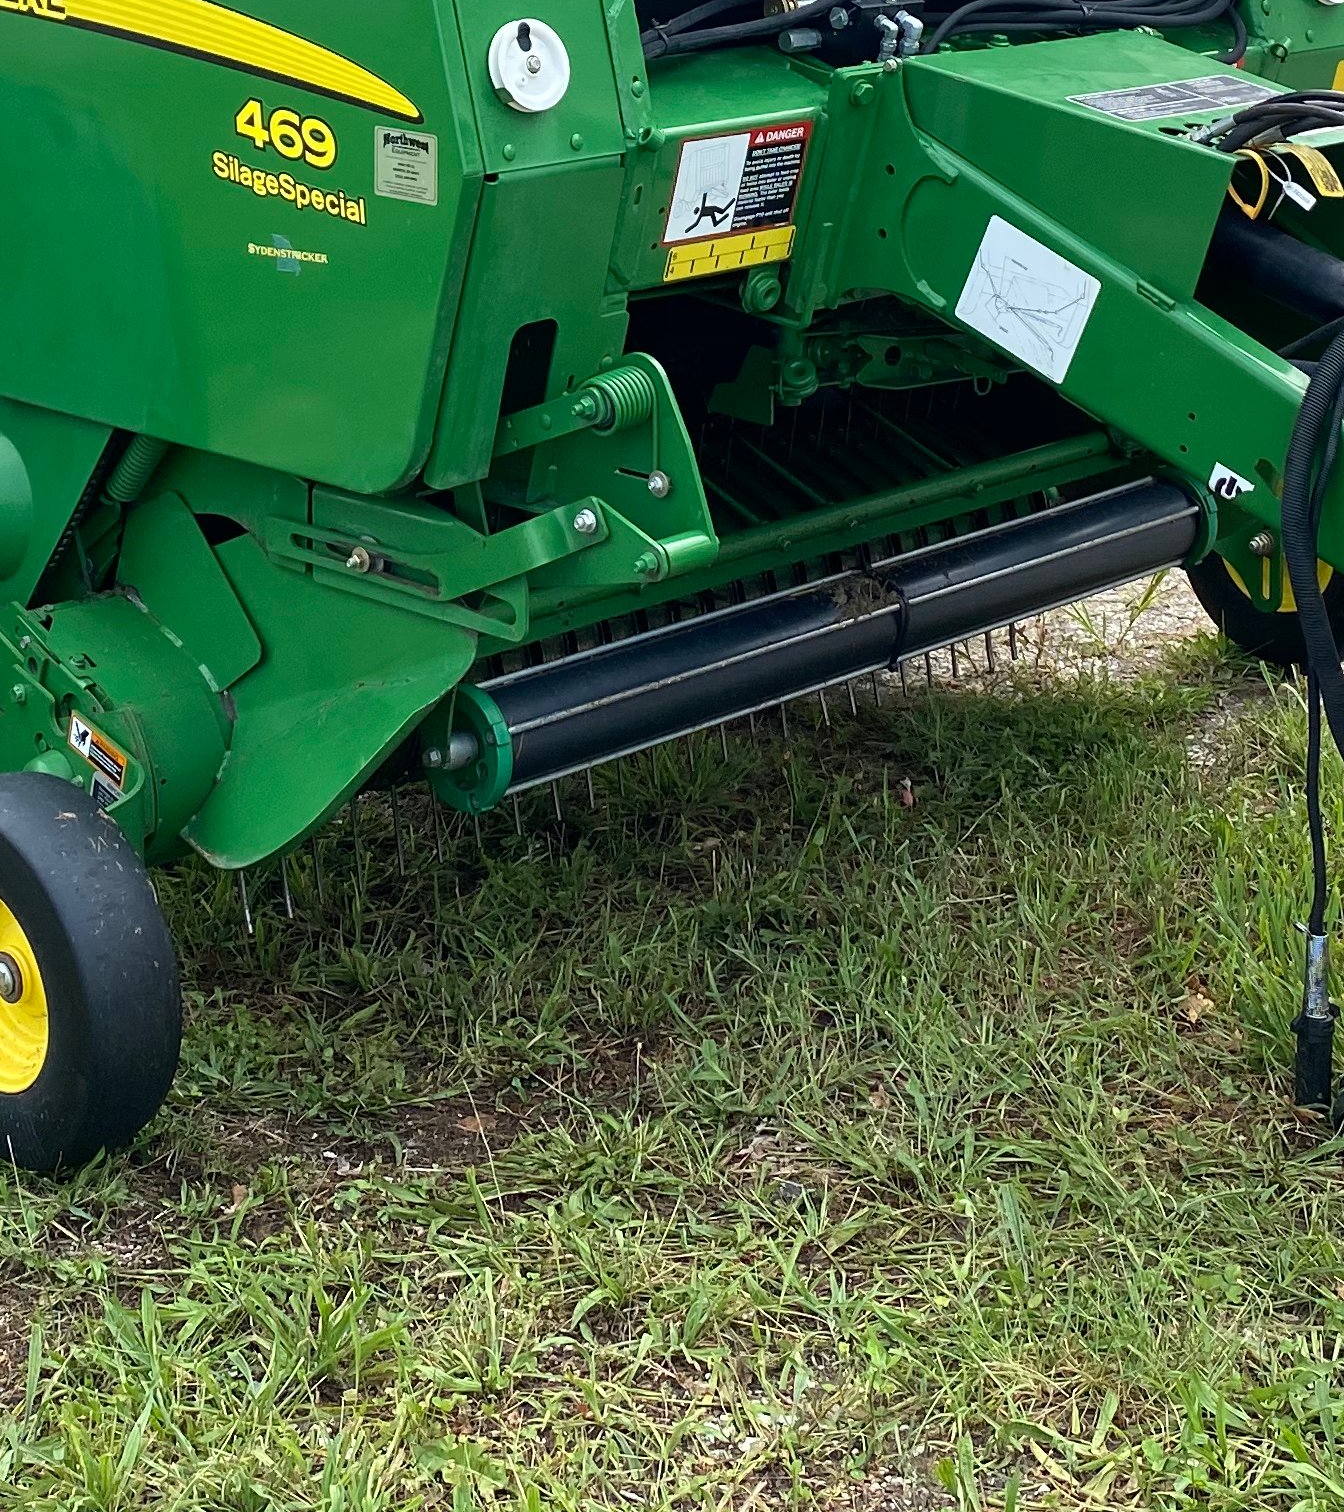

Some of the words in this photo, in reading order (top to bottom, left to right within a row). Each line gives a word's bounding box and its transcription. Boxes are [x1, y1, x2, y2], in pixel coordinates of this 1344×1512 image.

[235, 98, 337, 170] 469
[765, 127, 805, 142] DANGER
[212, 150, 367, 226] SilageSpecial
[247, 242, 329, 265] SYDENSTRICKER
